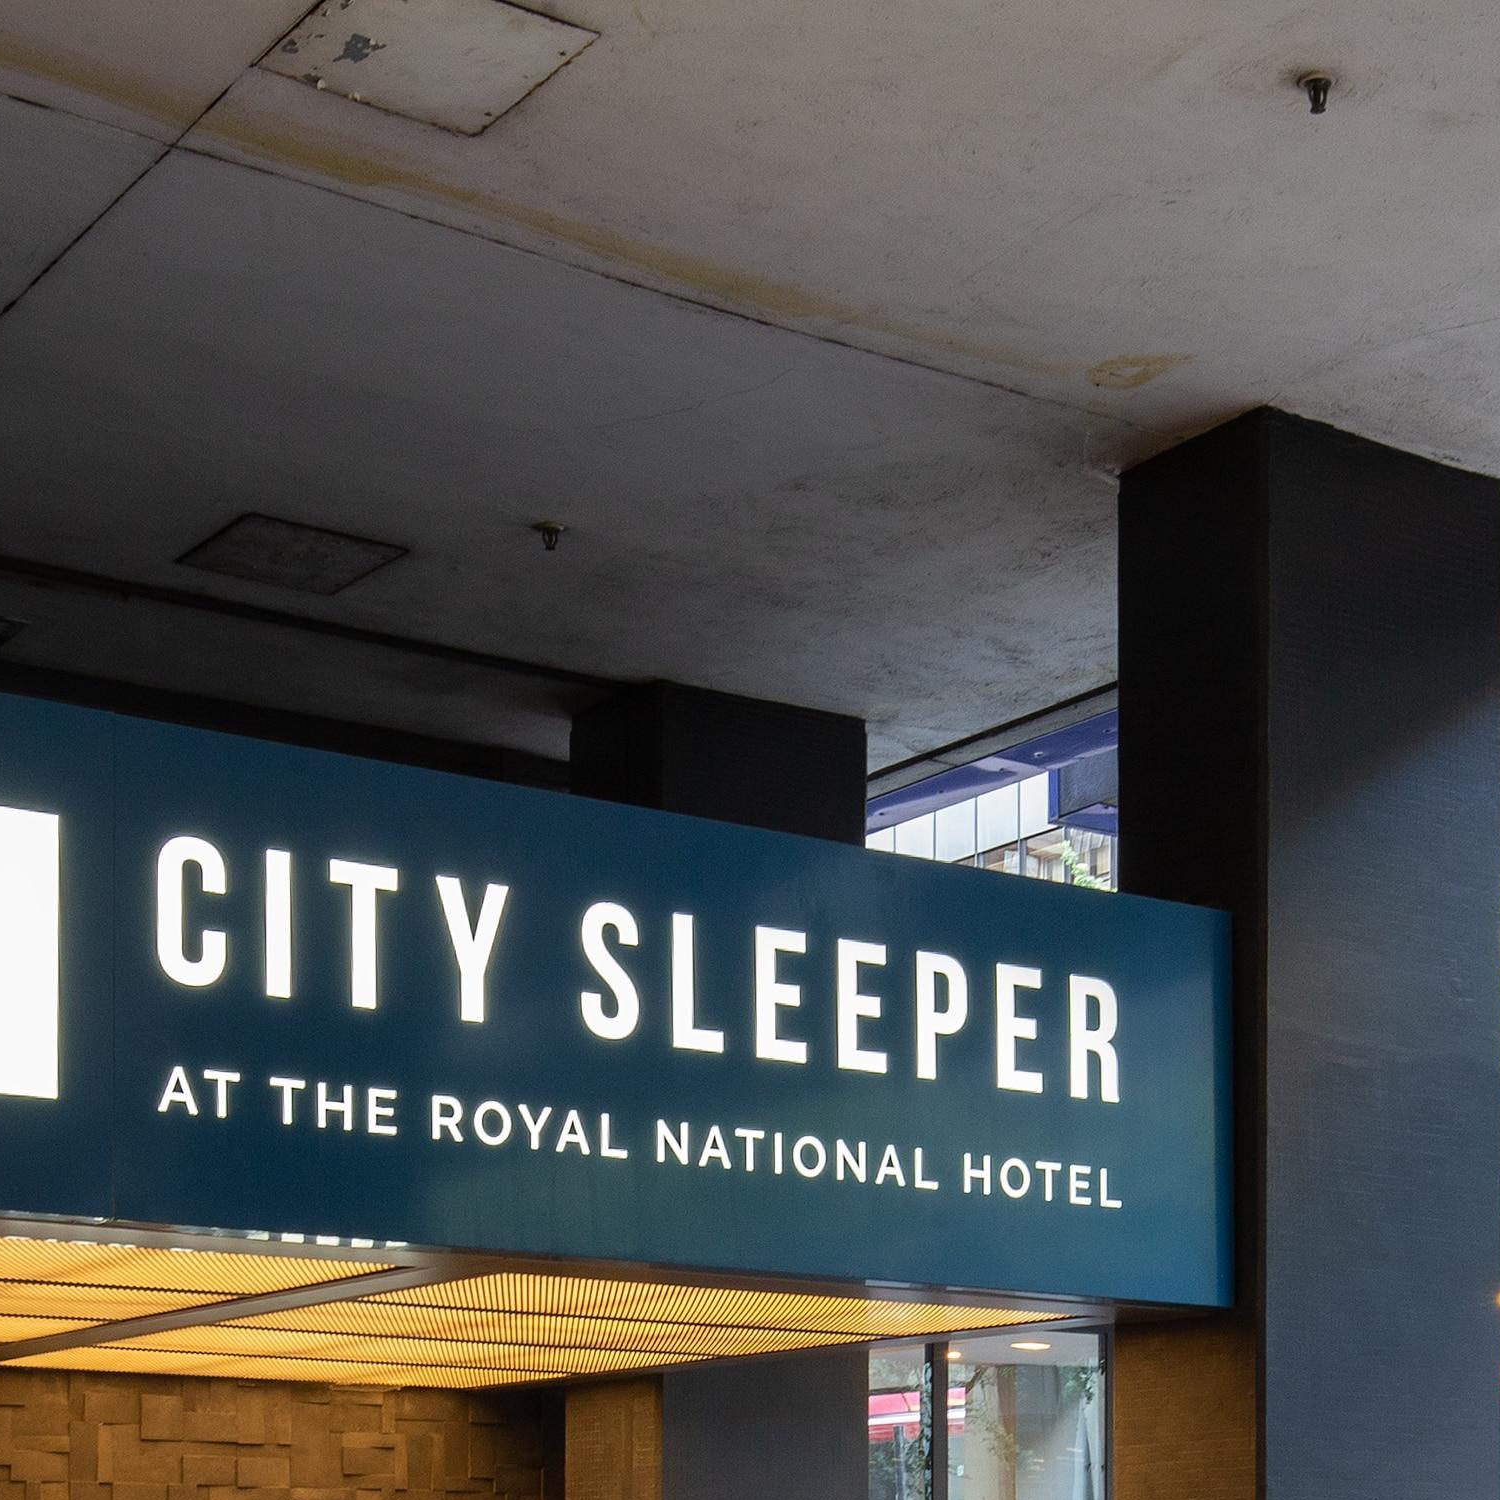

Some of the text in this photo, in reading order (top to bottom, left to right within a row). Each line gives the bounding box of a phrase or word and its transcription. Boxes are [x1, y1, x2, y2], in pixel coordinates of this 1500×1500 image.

[156, 834, 1122, 1105] CITY SLEEPER
[156, 1064, 1124, 1210] AT THE ROYAL NATIONAL HOTEL
